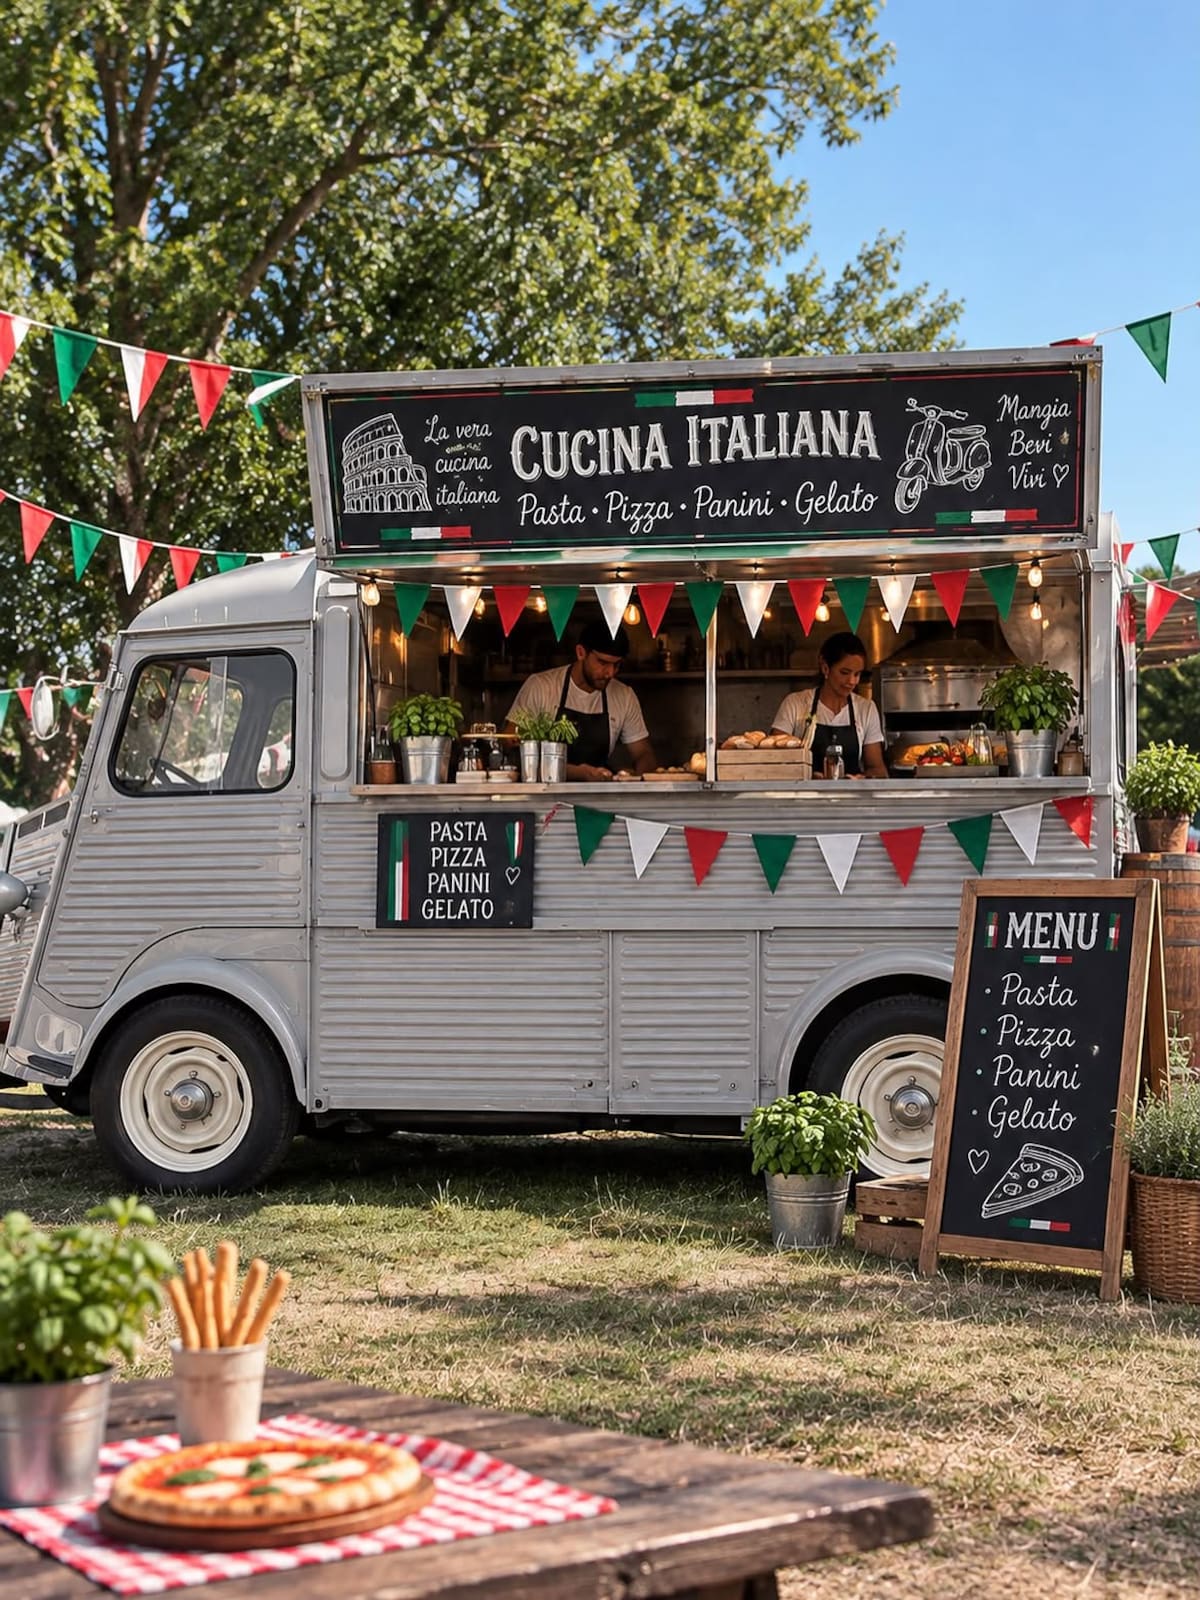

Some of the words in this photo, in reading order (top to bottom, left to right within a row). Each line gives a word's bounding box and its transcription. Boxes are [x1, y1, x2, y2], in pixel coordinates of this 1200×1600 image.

[996, 394, 1071, 430] Mangia
[424, 414, 450, 445] La
[456, 423, 493, 438] vera
[1008, 430, 1053, 457] Bevi
[510, 423, 673, 481] CUCINA
[686, 410, 881, 467] ITALIANA
[435, 452, 492, 474] cucina
[1008, 462, 1046, 490] Vivi
[436, 480, 501, 506] italiana
[518, 493, 586, 526] Pasta
[605, 490, 674, 534] Pizza
[694, 484, 774, 519] Panini
[795, 480, 879, 526] Gelato
[430, 821, 488, 842] PASTA
[431, 847, 487, 867] PIZZA
[428, 872, 490, 893] PANINI
[421, 899, 494, 919] GELATO
[1005, 912, 1099, 951] MENU
[1001, 973, 1078, 1007] Pasta
[997, 1014, 1076, 1059] Pizza
[992, 1054, 1081, 1090] Panini
[987, 1095, 1077, 1138] Gelato
